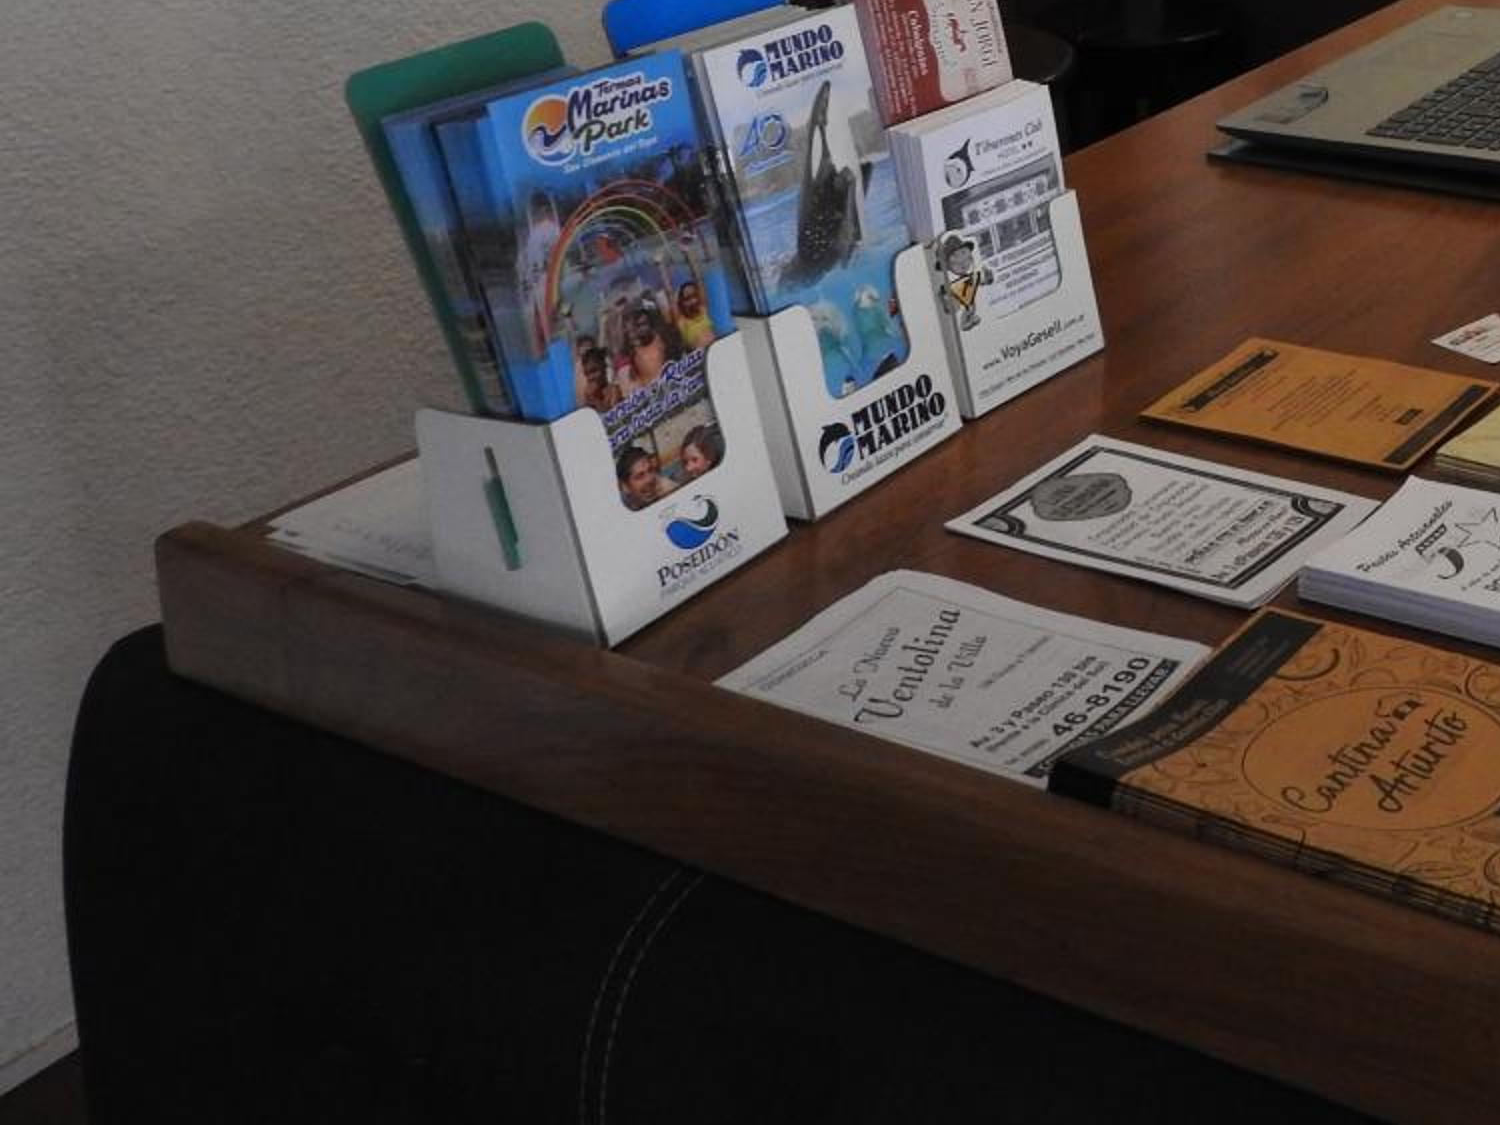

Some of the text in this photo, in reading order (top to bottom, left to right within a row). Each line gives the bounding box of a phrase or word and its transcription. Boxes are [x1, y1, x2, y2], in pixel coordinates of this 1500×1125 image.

[763, 23, 833, 61] MUNDO
[769, 39, 845, 82] MARINO
[567, 79, 671, 132] Marinas
[593, 73, 643, 96] Termas
[572, 109, 650, 152] Park
[850, 373, 933, 435] MUNDO
[856, 391, 946, 461] MARINO
[837, 624, 902, 703] La Nueva
[853, 605, 962, 727] Ventolina
[929, 633, 989, 711] de la Villa
[1052, 655, 1151, 737] 46-8190
[1011, 689, 1054, 720] Paseo
[1281, 706, 1396, 815] Cantina
[1376, 709, 1467, 815] Arturito
